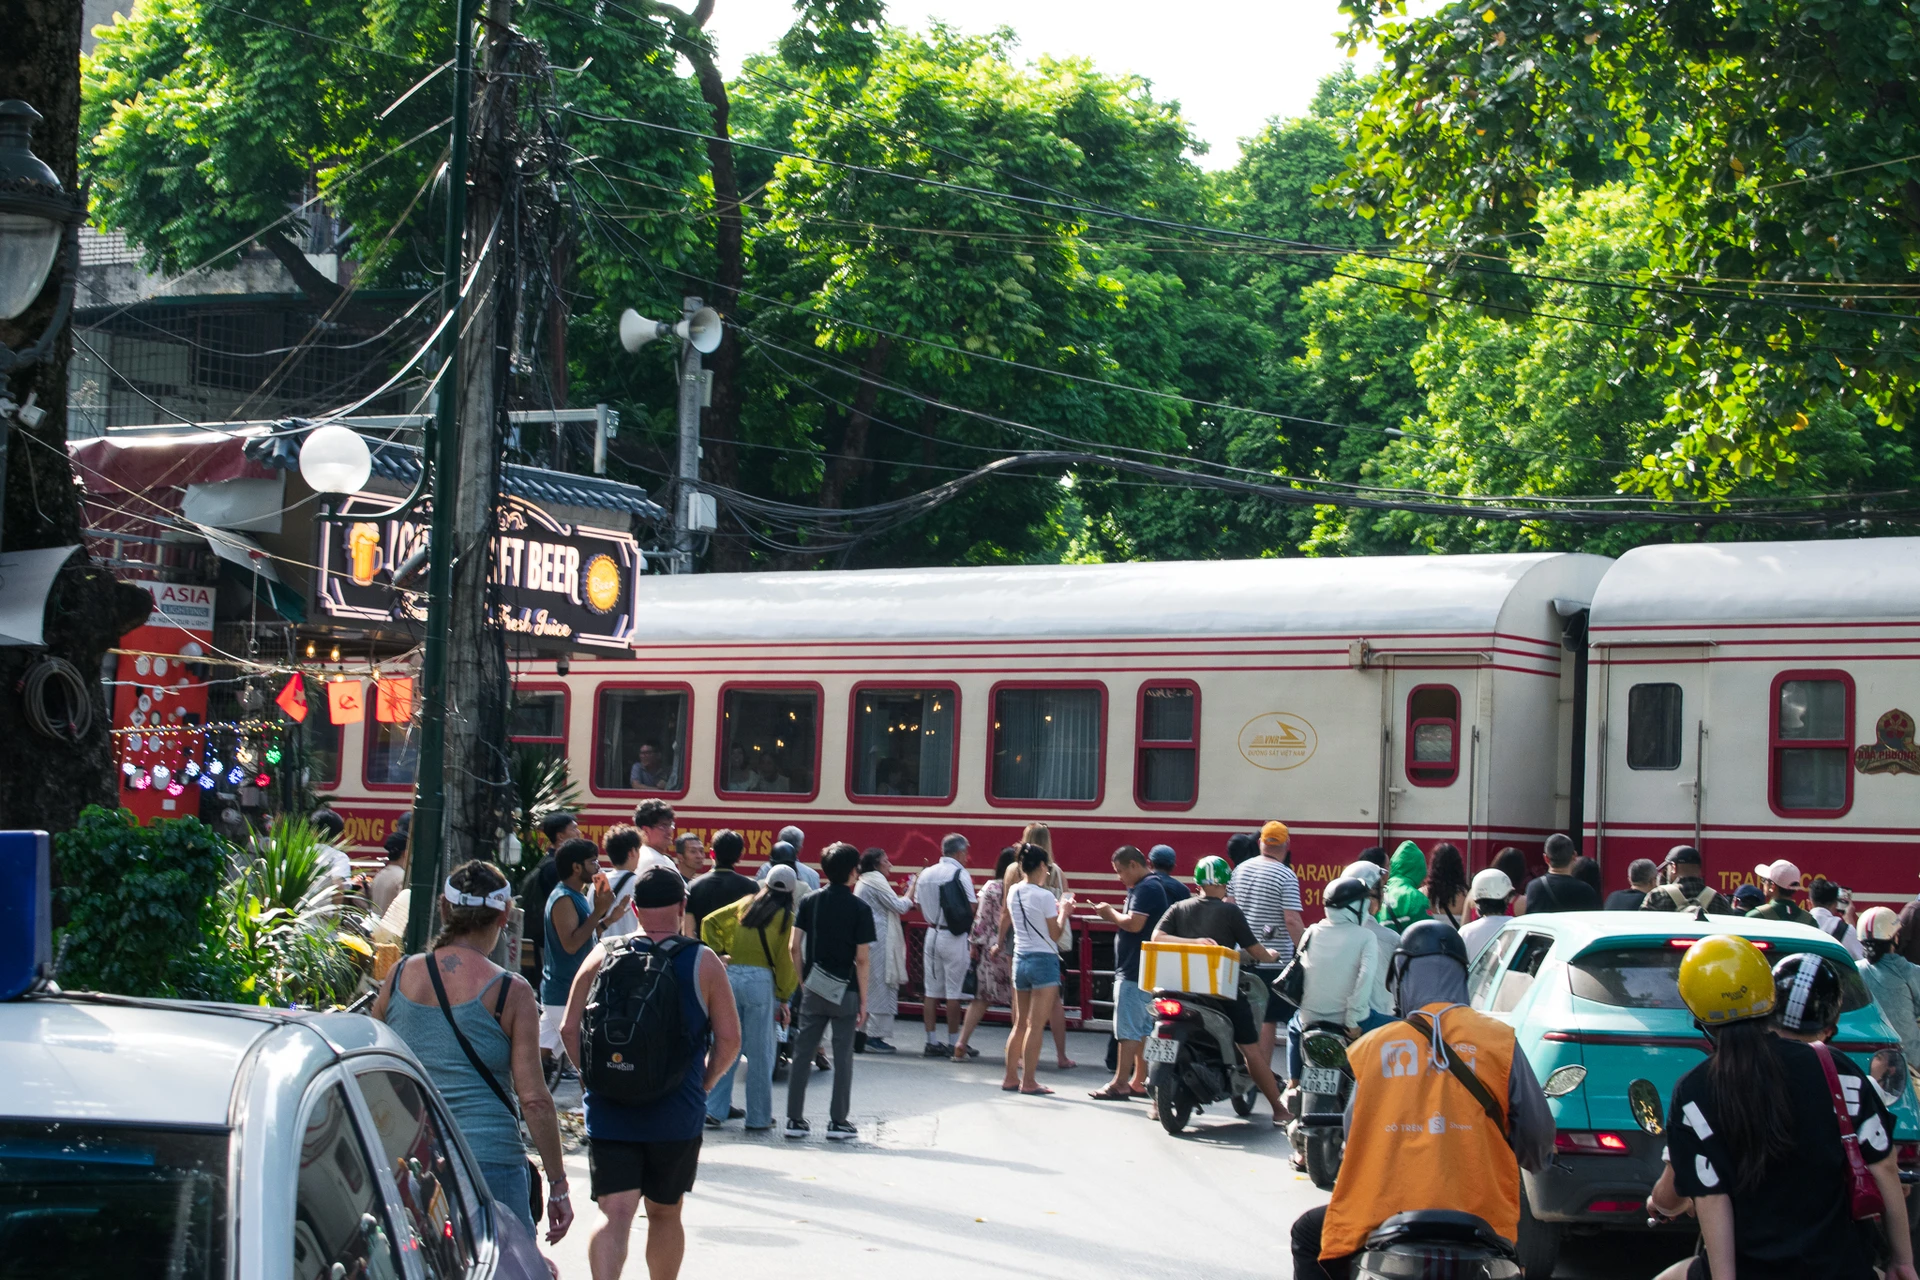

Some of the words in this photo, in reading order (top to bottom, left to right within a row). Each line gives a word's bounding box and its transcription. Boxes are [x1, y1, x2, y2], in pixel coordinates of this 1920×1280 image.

[527, 540, 583, 606] BEER
[161, 586, 210, 604] ASIA
[163, 605, 208, 616] LIGHTING
[533, 608, 573, 638] Juice
